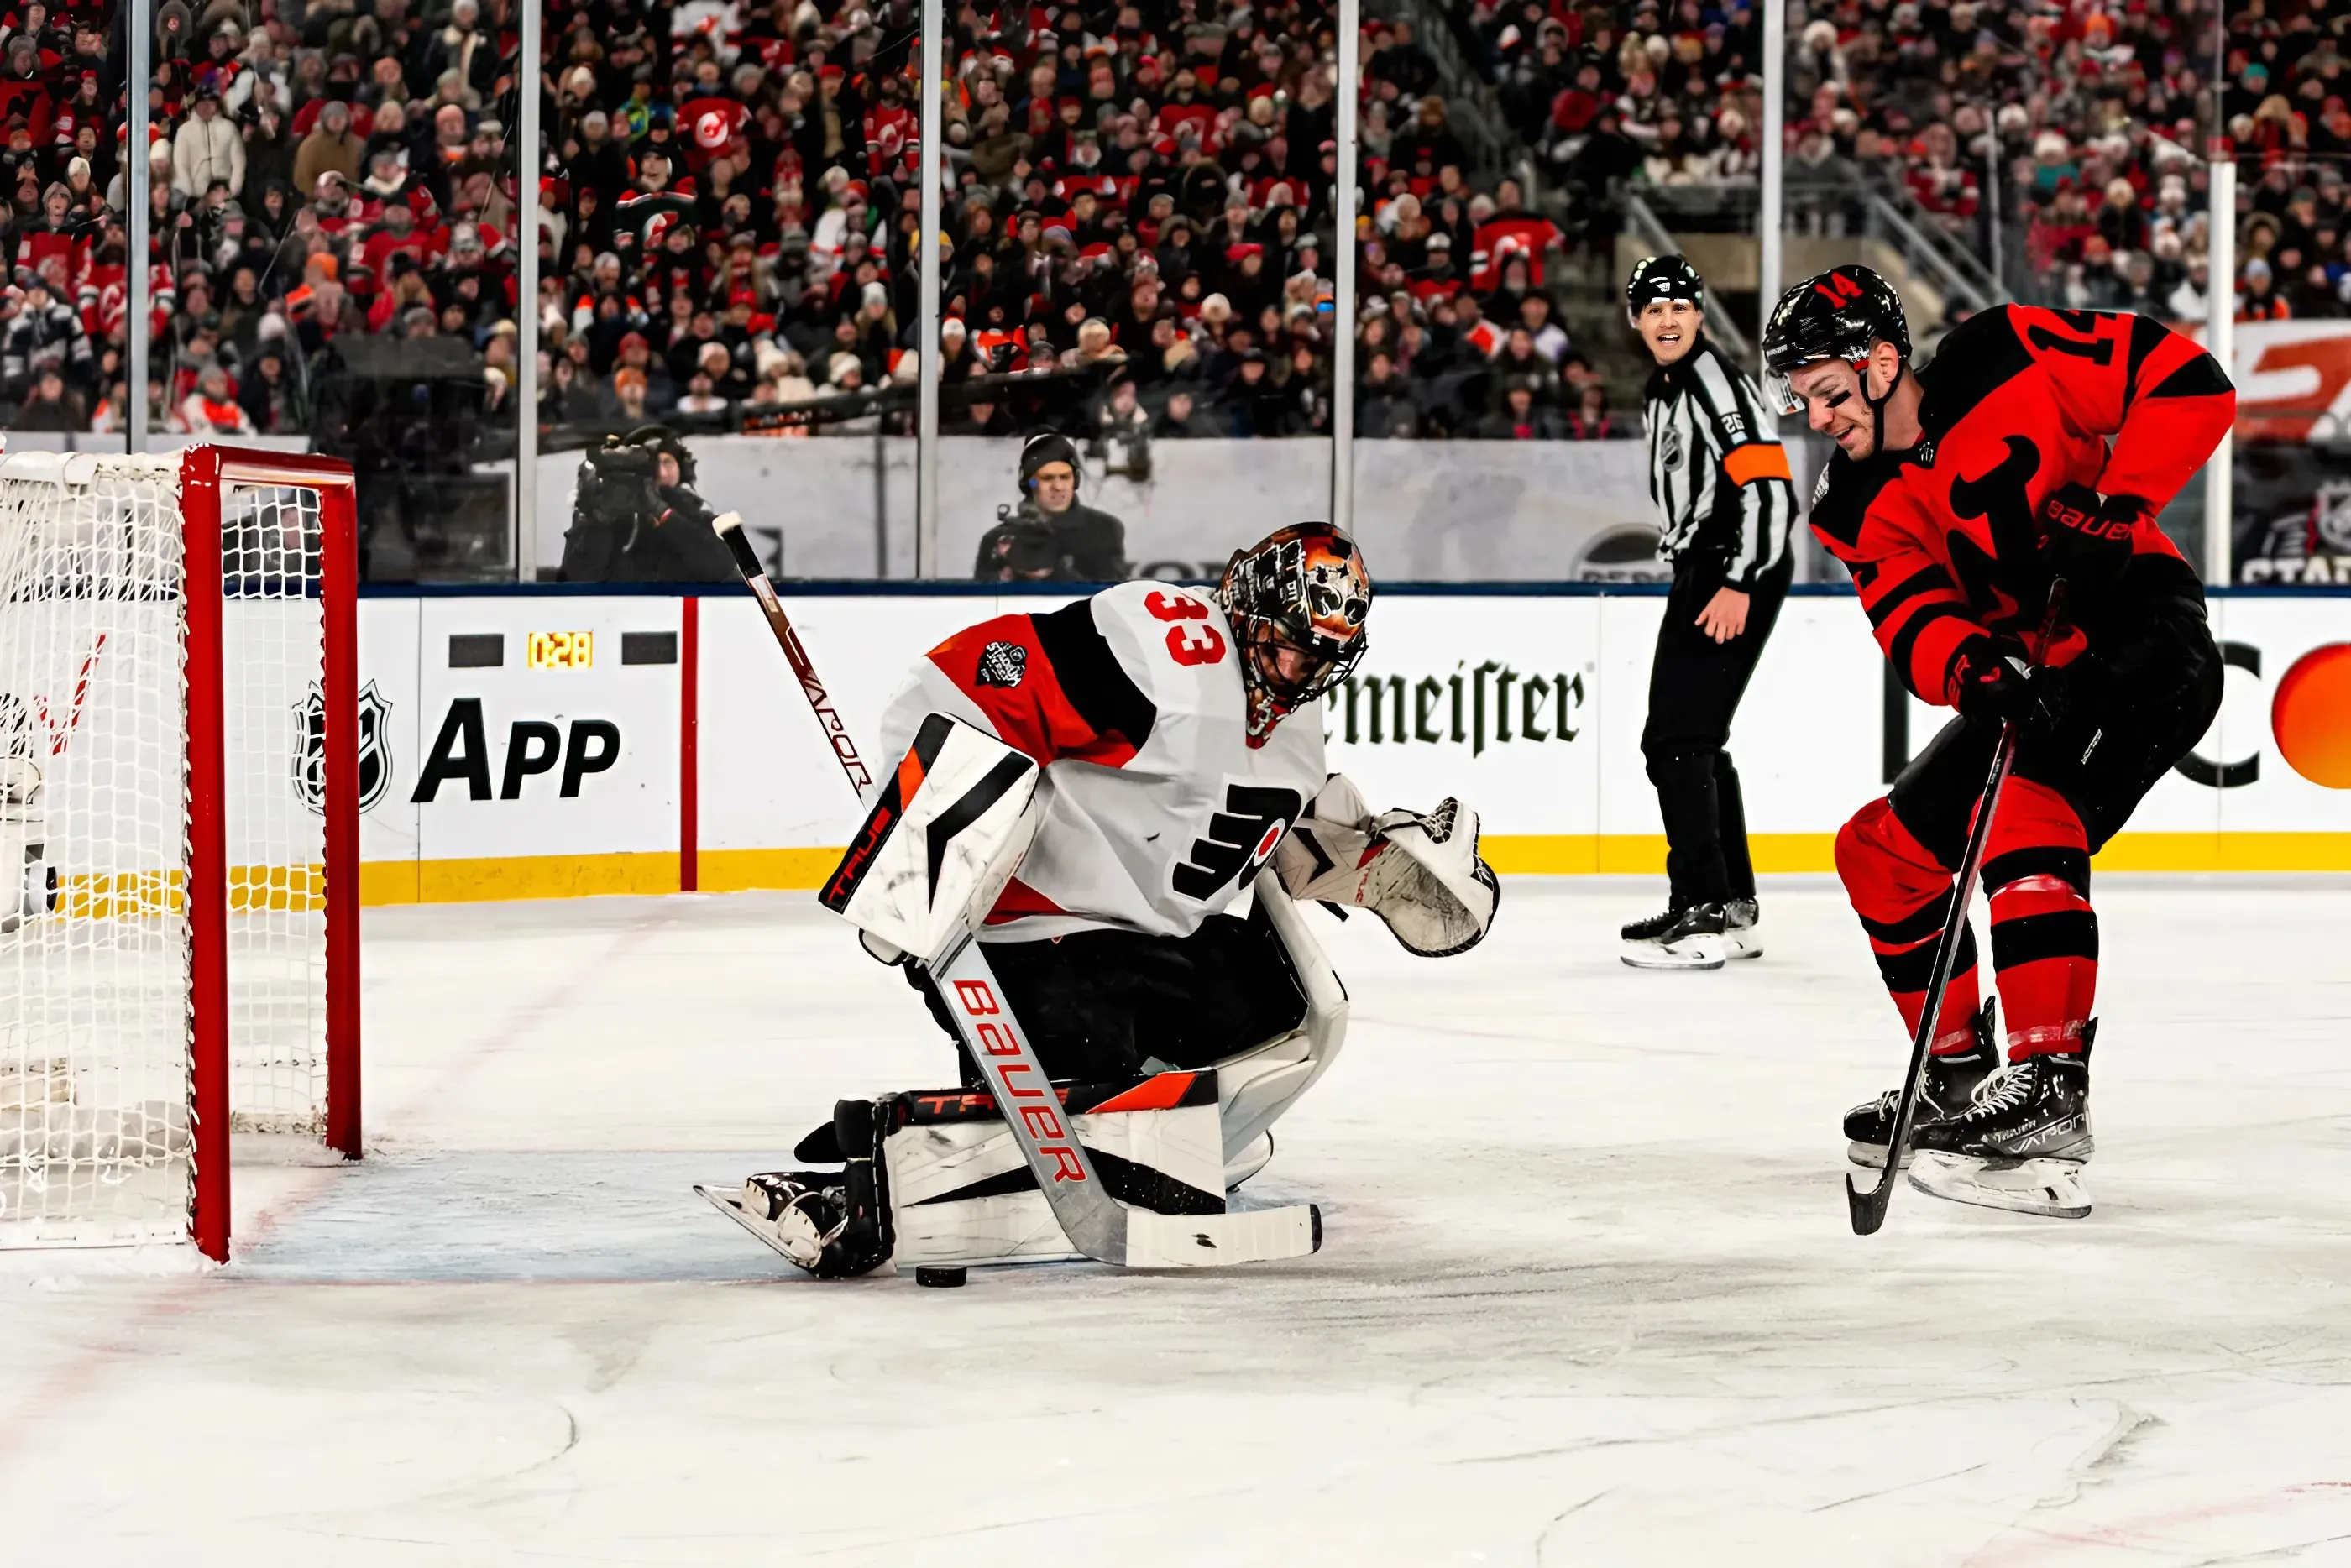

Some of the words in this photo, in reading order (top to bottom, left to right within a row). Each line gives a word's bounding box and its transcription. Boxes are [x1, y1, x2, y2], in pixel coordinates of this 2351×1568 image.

[1814, 272, 1864, 309] 14
[1721, 414, 1745, 433] 26
[2047, 500, 2133, 541] BAUE
[1144, 591, 1227, 666] 33
[531, 631, 591, 668] 0:28
